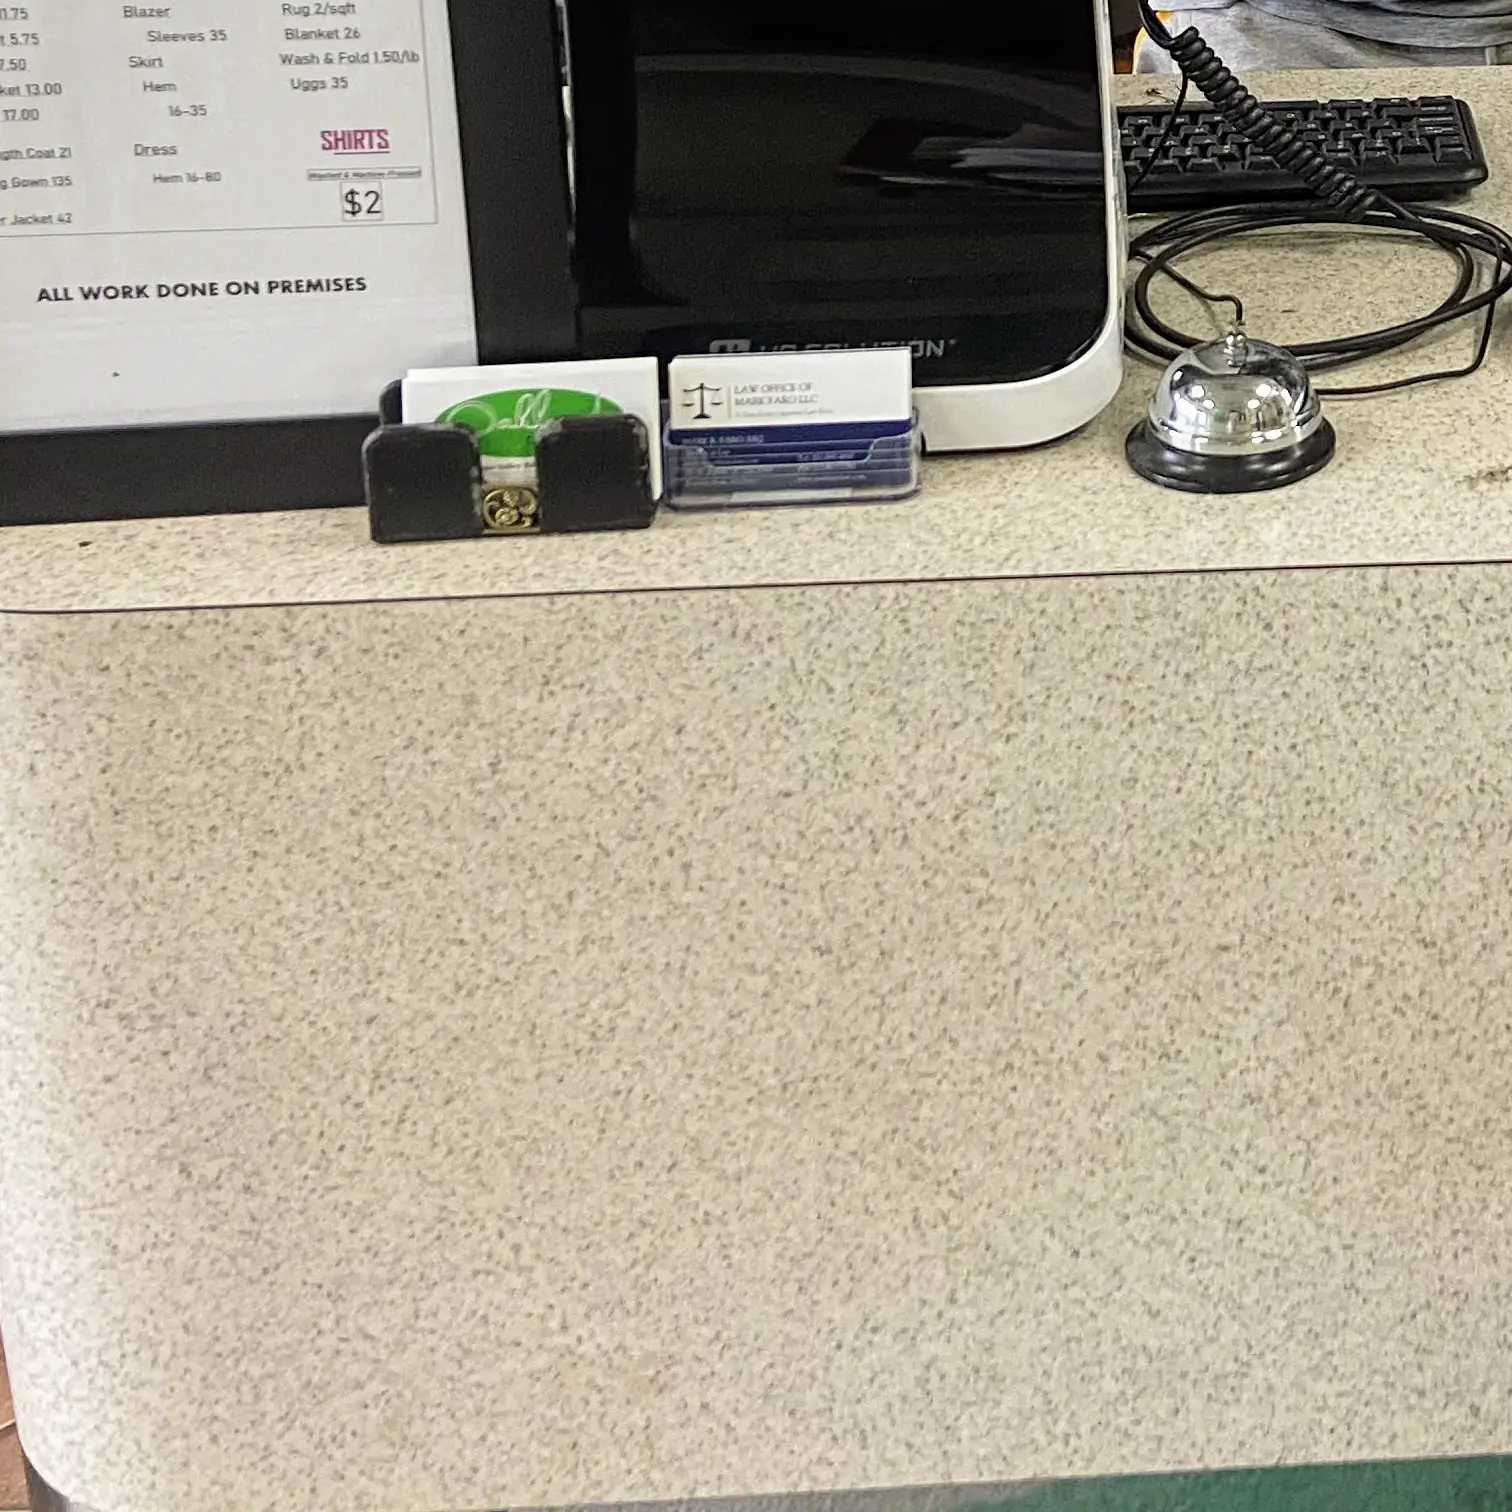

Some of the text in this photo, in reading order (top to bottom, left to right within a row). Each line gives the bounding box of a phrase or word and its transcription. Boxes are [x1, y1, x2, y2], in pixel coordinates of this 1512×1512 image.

[123, 5, 171, 18] Blazer
[282, 3, 309, 16] Rug
[10, 33, 40, 45] 5.75
[147, 29, 227, 42] Sleeves 35
[285, 27, 361, 39] Blanket 26
[128, 56, 164, 68] Skirt
[279, 53, 319, 65] Wash
[324, 53, 334, 64] &
[338, 51, 369, 64] Fold
[25, 83, 63, 95] 13.00
[143, 81, 177, 92] Hem
[291, 77, 349, 91] Uggs 35
[3, 109, 40, 121] 17.00
[168, 105, 207, 117] 16-35
[321, 129, 390, 151] SHIRTS
[134, 143, 178, 156] Dress
[52, 176, 72, 187] 135
[153, 174, 183, 183] Hem
[345, 188, 382, 217] $2
[37, 277, 367, 303] ALL WORK DONE ON PREMISES
